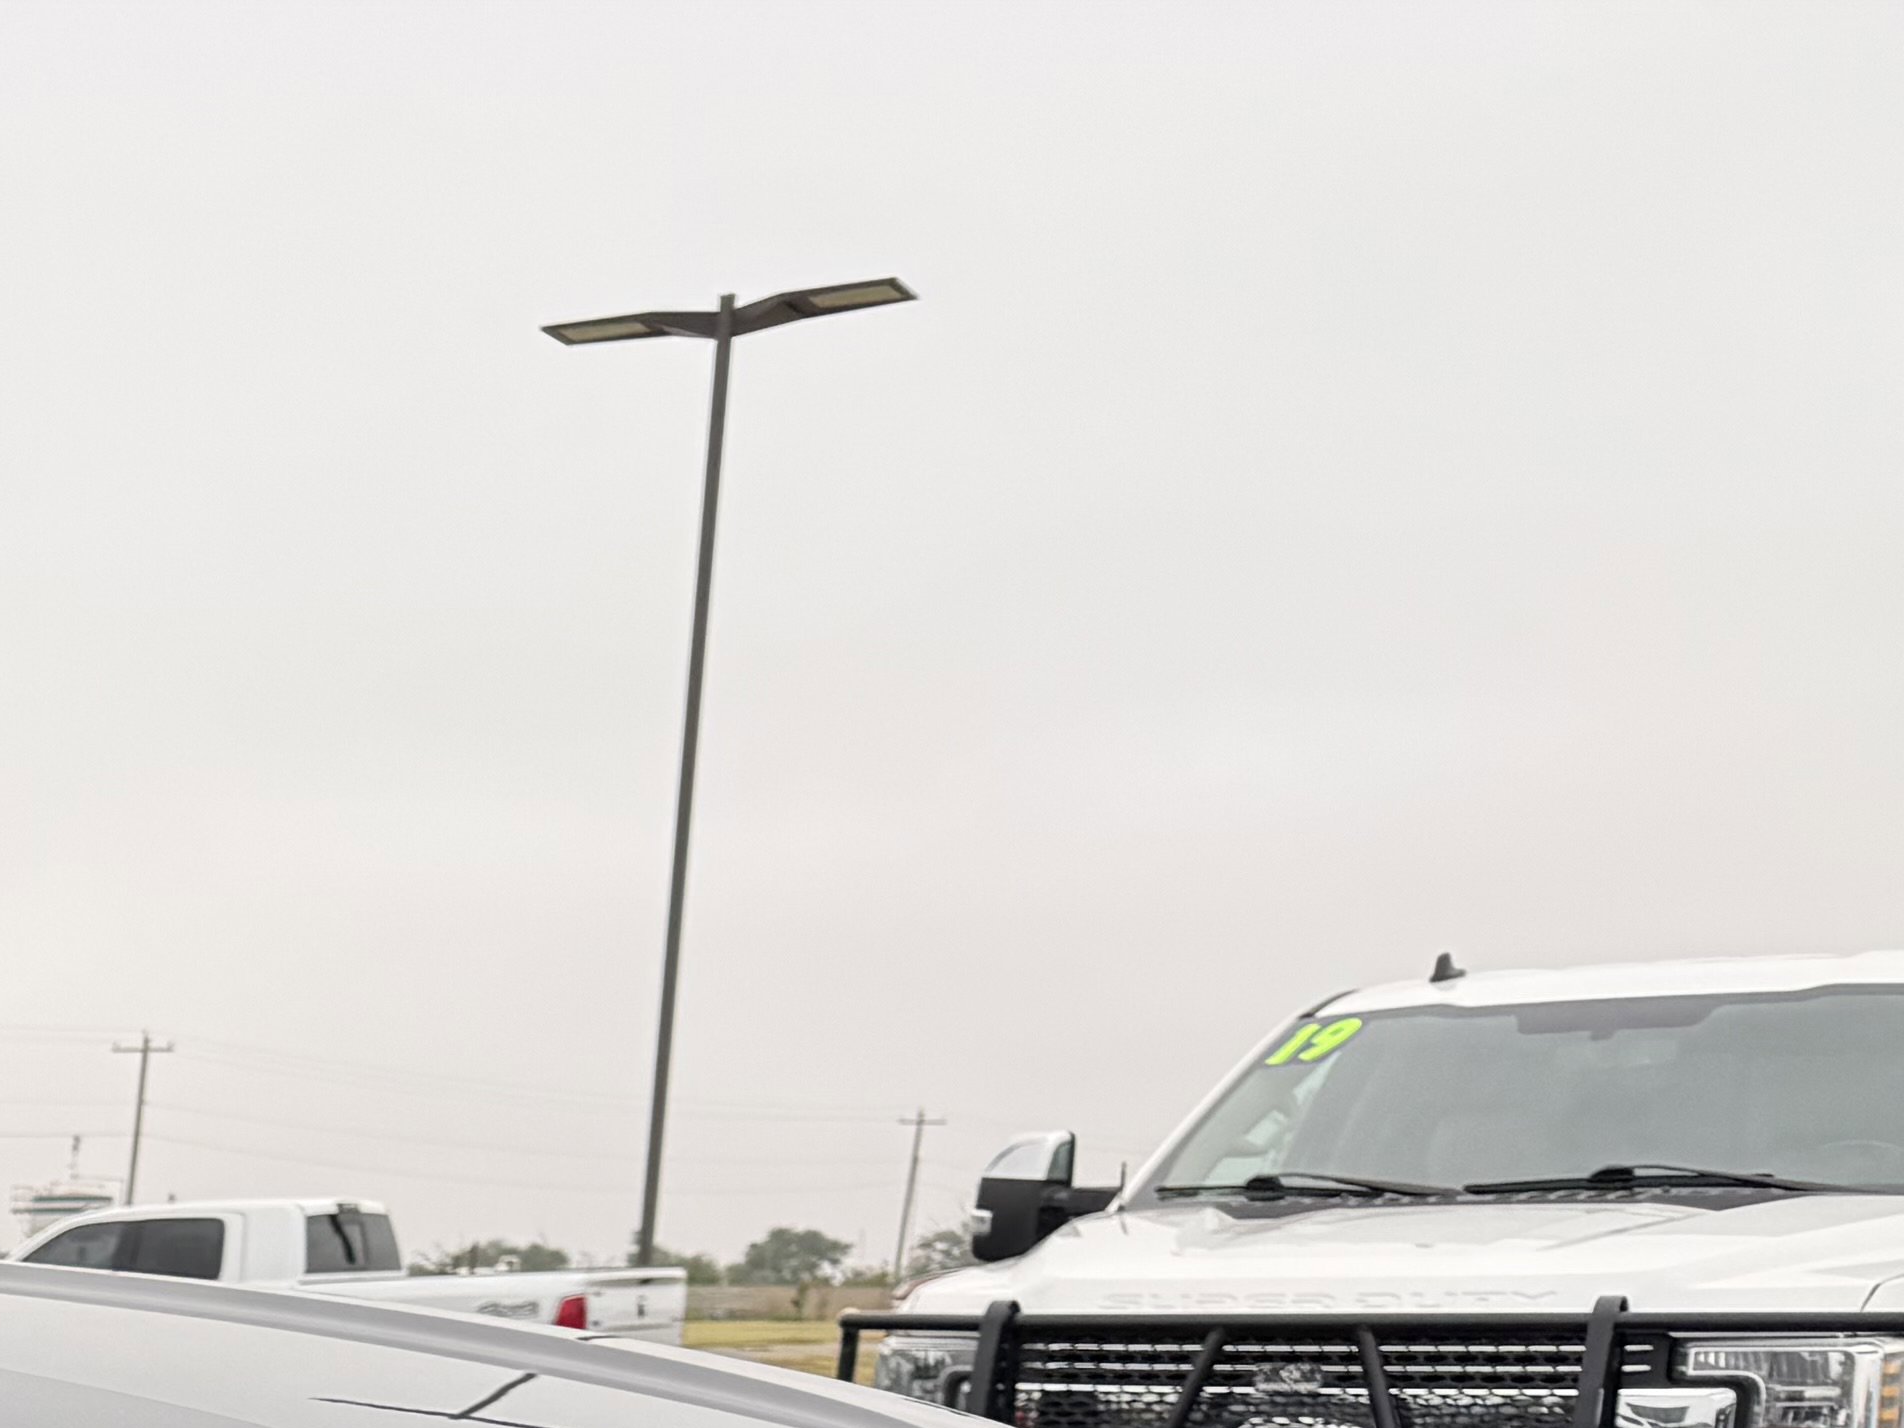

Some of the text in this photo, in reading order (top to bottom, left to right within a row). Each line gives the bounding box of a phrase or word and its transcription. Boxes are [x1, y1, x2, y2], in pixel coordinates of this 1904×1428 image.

[1264, 1017, 1363, 1066] 19
[1097, 1290, 1558, 1310] SUPER DUTY
